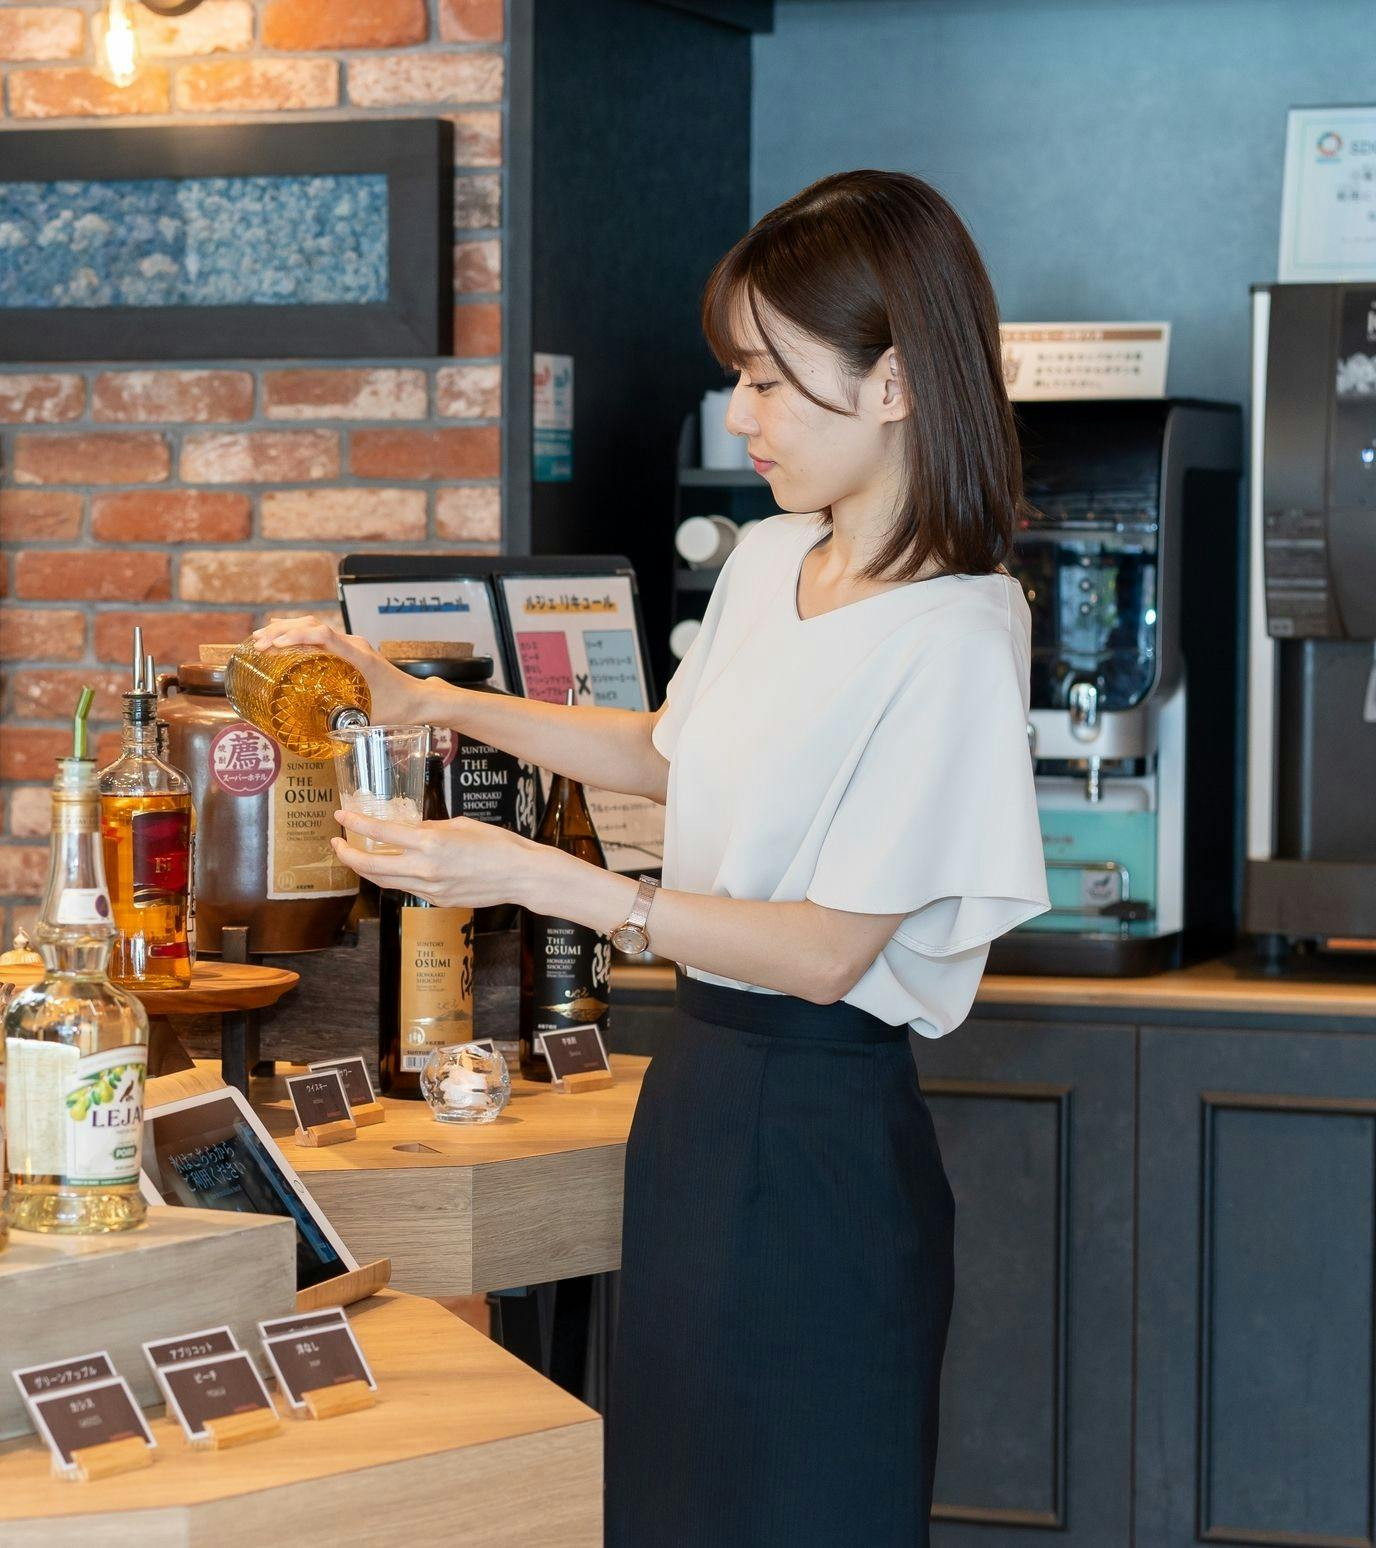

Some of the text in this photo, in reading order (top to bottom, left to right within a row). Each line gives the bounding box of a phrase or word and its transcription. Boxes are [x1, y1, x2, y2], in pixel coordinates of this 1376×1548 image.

[287, 762, 325, 771] SUNTORY
[461, 759, 488, 770] THE
[223, 773, 267, 782] スーパーホテル
[288, 776, 313, 787] THE
[460, 770, 509, 786] OSUMI
[284, 788, 333, 803] OSUMI
[462, 791, 502, 801] HONKAKU
[462, 801, 498, 810] SHOCHU
[287, 810, 327, 819] HONKAKU
[286, 820, 322, 828] SHOCHU
[546, 937, 565, 945] THE
[417, 950, 435, 958] THE
[545, 945, 581, 956] OSUMI
[414, 958, 451, 968] OSUMI
[34, 1366, 97, 1389] グリーンアップル
